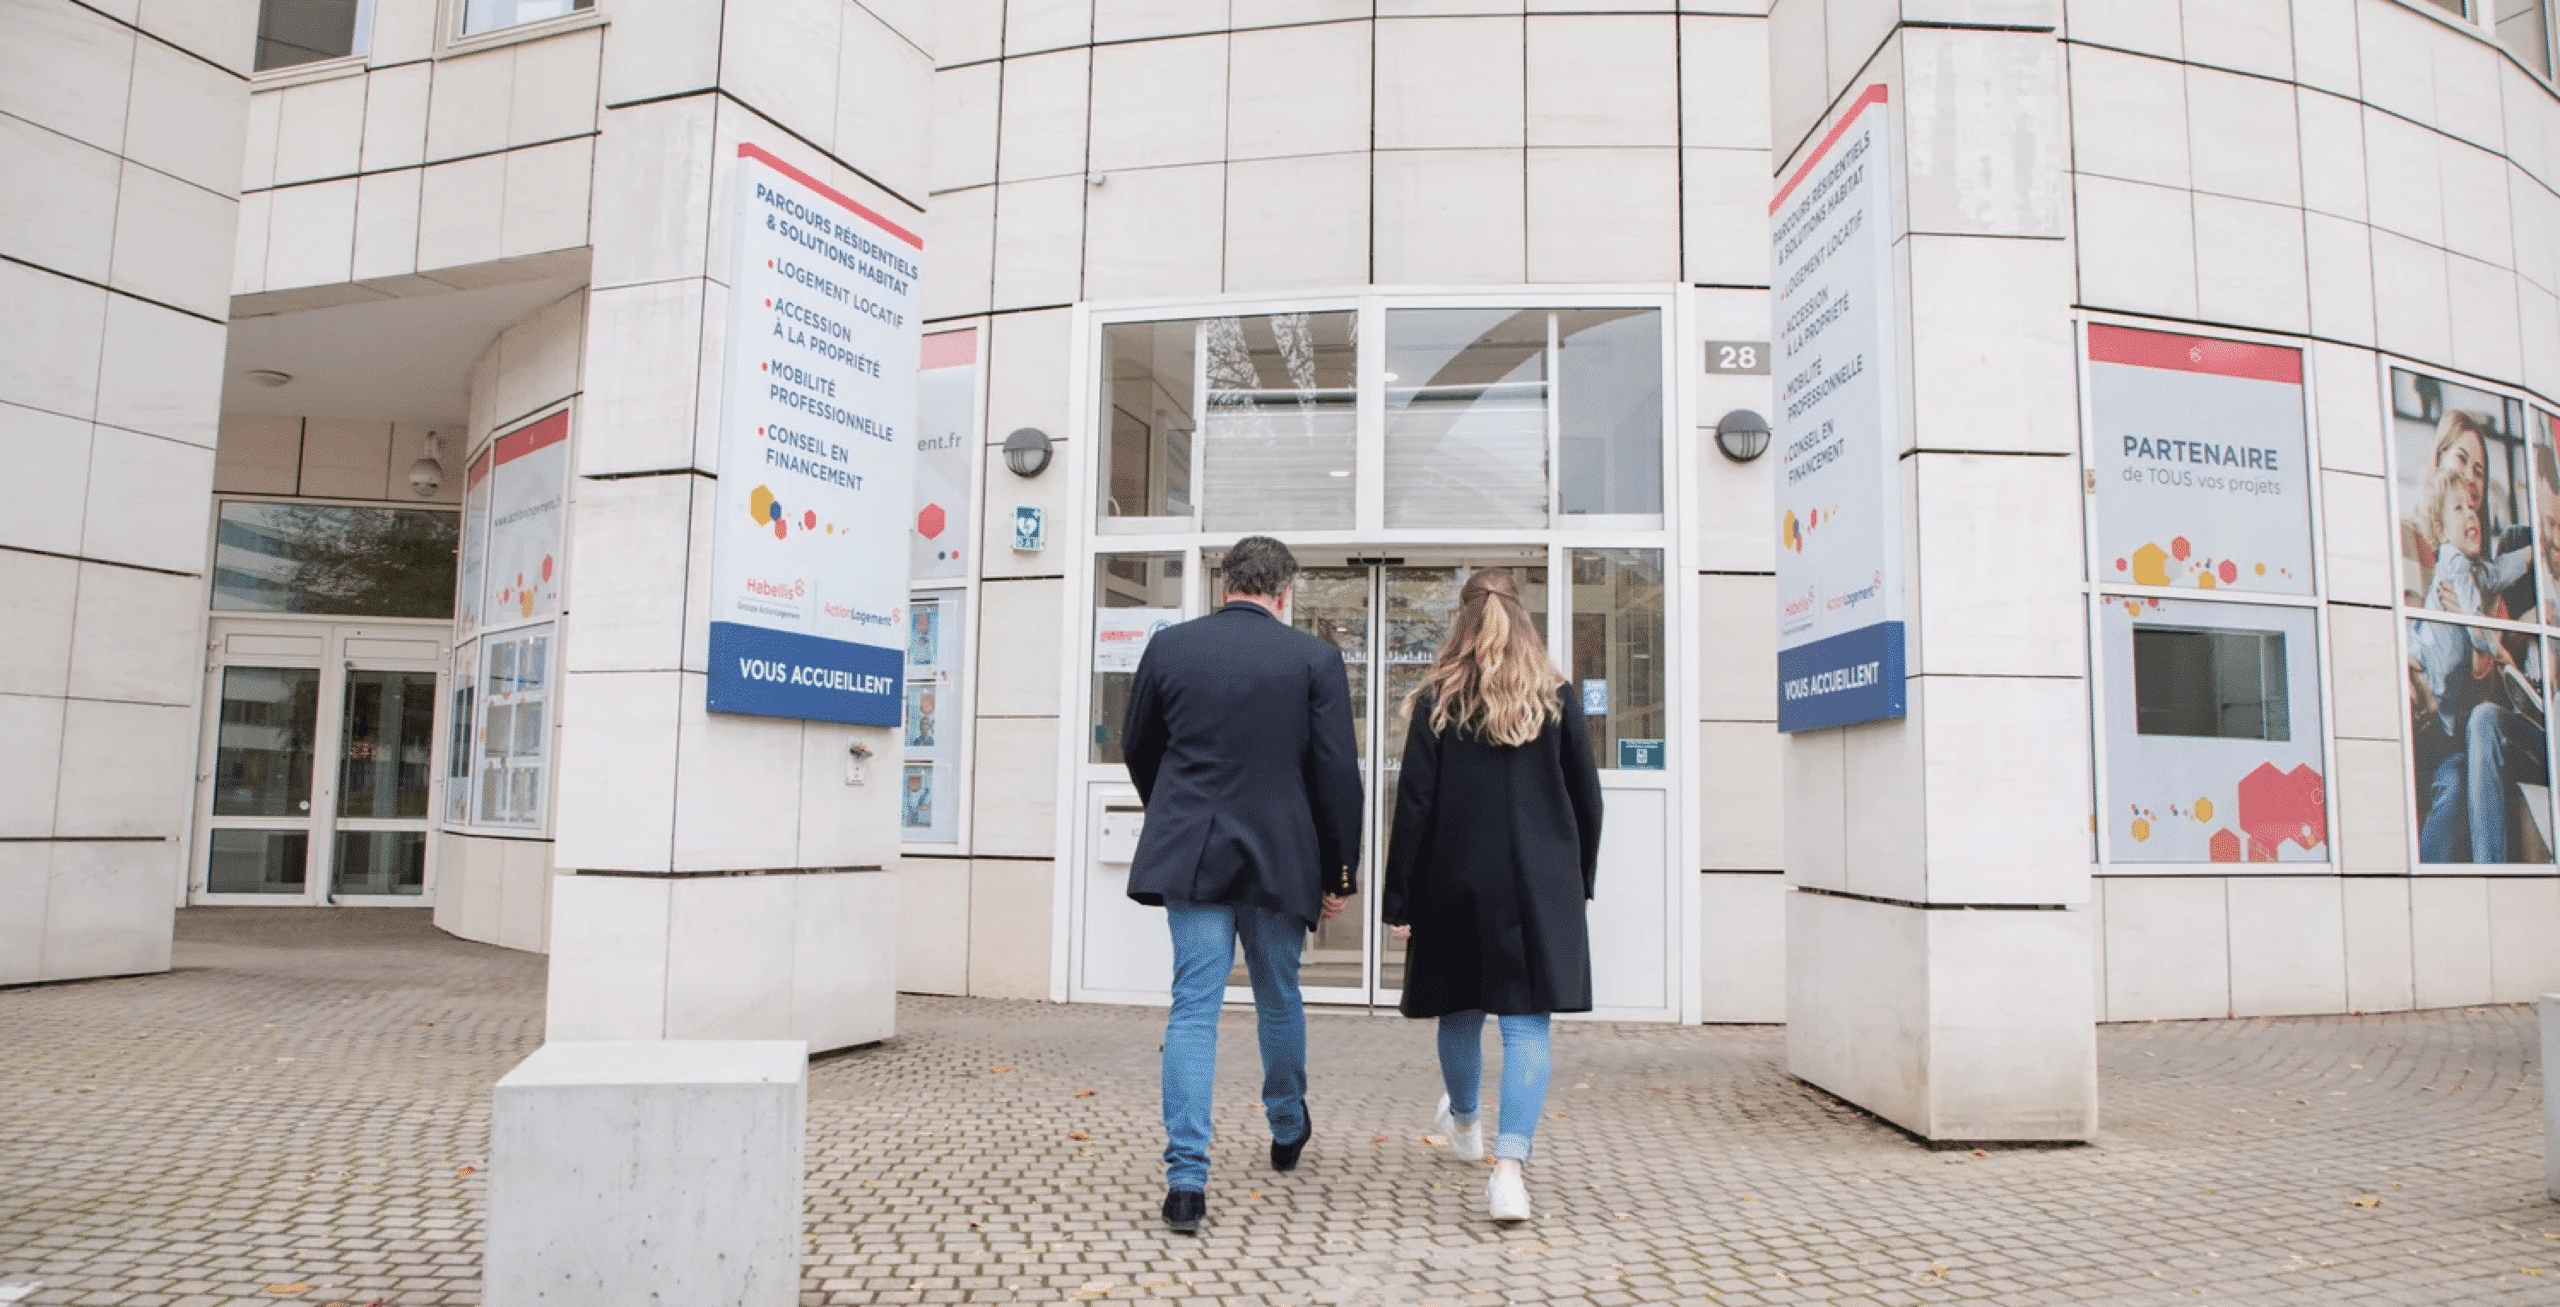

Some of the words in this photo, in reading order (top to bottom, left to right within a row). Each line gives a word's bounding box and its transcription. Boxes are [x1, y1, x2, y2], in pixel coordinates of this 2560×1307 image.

[757, 183, 832, 235] PARCOURS
[834, 224, 918, 280] RÉSIDENTIELS
[1773, 195, 1810, 246] PARCOURS
[1785, 203, 1826, 260] SOLUTIONS
[1828, 163, 1864, 215] HABITAT
[766, 214, 776, 231] &
[779, 219, 855, 271] SOLUTIONS
[858, 257, 909, 297] HABITAT
[1785, 245, 1825, 298] LOGEMENT
[1827, 208, 1863, 258] LOCATIF
[777, 257, 850, 305] LOGEMENT
[853, 294, 904, 329] LOCATIF
[1786, 286, 1828, 333] ACCESSION
[774, 298, 852, 343] ACCESSION
[773, 317, 783, 338] À
[788, 327, 805, 347] LA
[810, 336, 881, 378] PROPRIÉTÉ
[1720, 346, 1757, 369] 28
[771, 359, 836, 398] MOBILITÉ
[1788, 354, 1862, 423] PROFESSIONNELLE
[770, 384, 893, 442] PROFESSIONNELLE
[767, 424, 827, 457] CONSEIL
[831, 445, 848, 464] EN
[1788, 428, 1820, 462] CONSEIL
[1822, 419, 1833, 440] EN
[1788, 437, 1844, 486] FINANCEMENT
[2123, 435, 2278, 471] PARTENAIRE
[766, 448, 863, 491] FINANCEMENT
[2122, 466, 2143, 482] de
[2147, 467, 2193, 487] TOUS
[2198, 476, 2224, 489] vos
[2229, 477, 2281, 495] projets
[747, 578, 794, 600] Habellis
[740, 657, 787, 684] VOUS
[790, 665, 893, 696] ACCUEILLENT
[1785, 676, 1809, 701] VOUS
[1811, 660, 1880, 697] ACCUEILLENT
